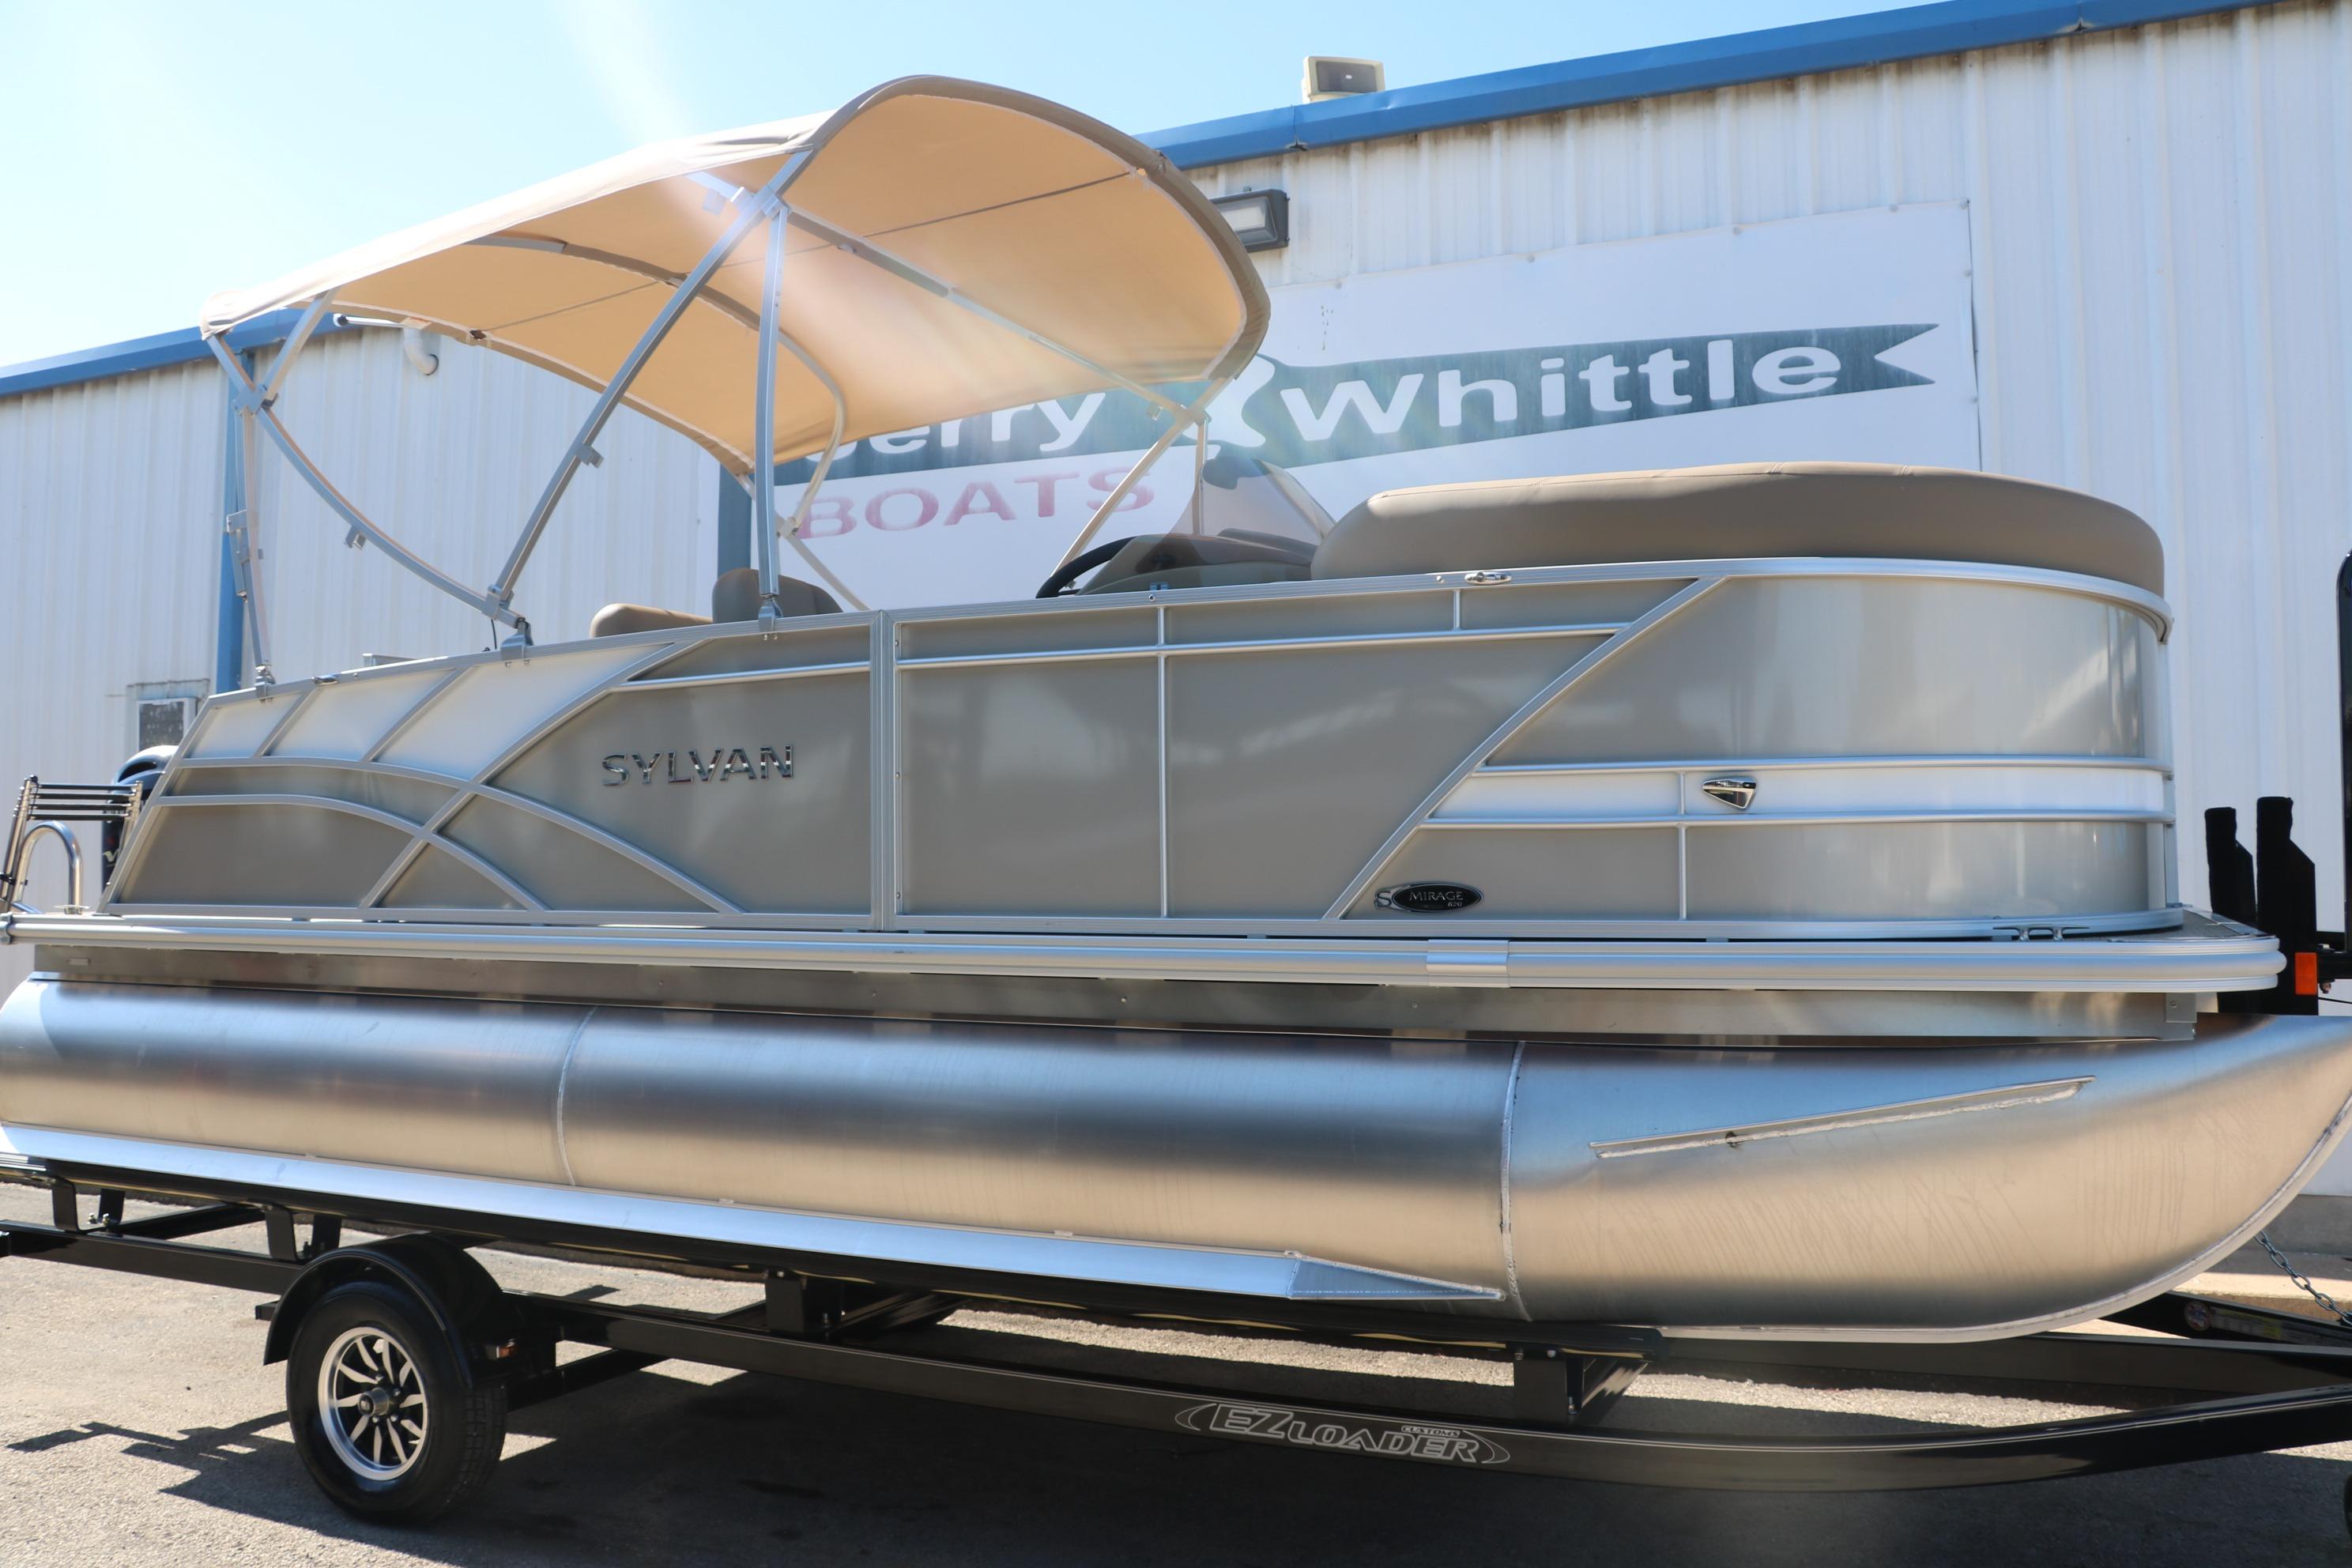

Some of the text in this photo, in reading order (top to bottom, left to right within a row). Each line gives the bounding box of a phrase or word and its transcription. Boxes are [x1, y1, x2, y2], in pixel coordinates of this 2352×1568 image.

[797, 466, 1155, 540] BOATS
[601, 745, 793, 786] SYLVAN
[1409, 891, 1464, 902] MIRAGE
